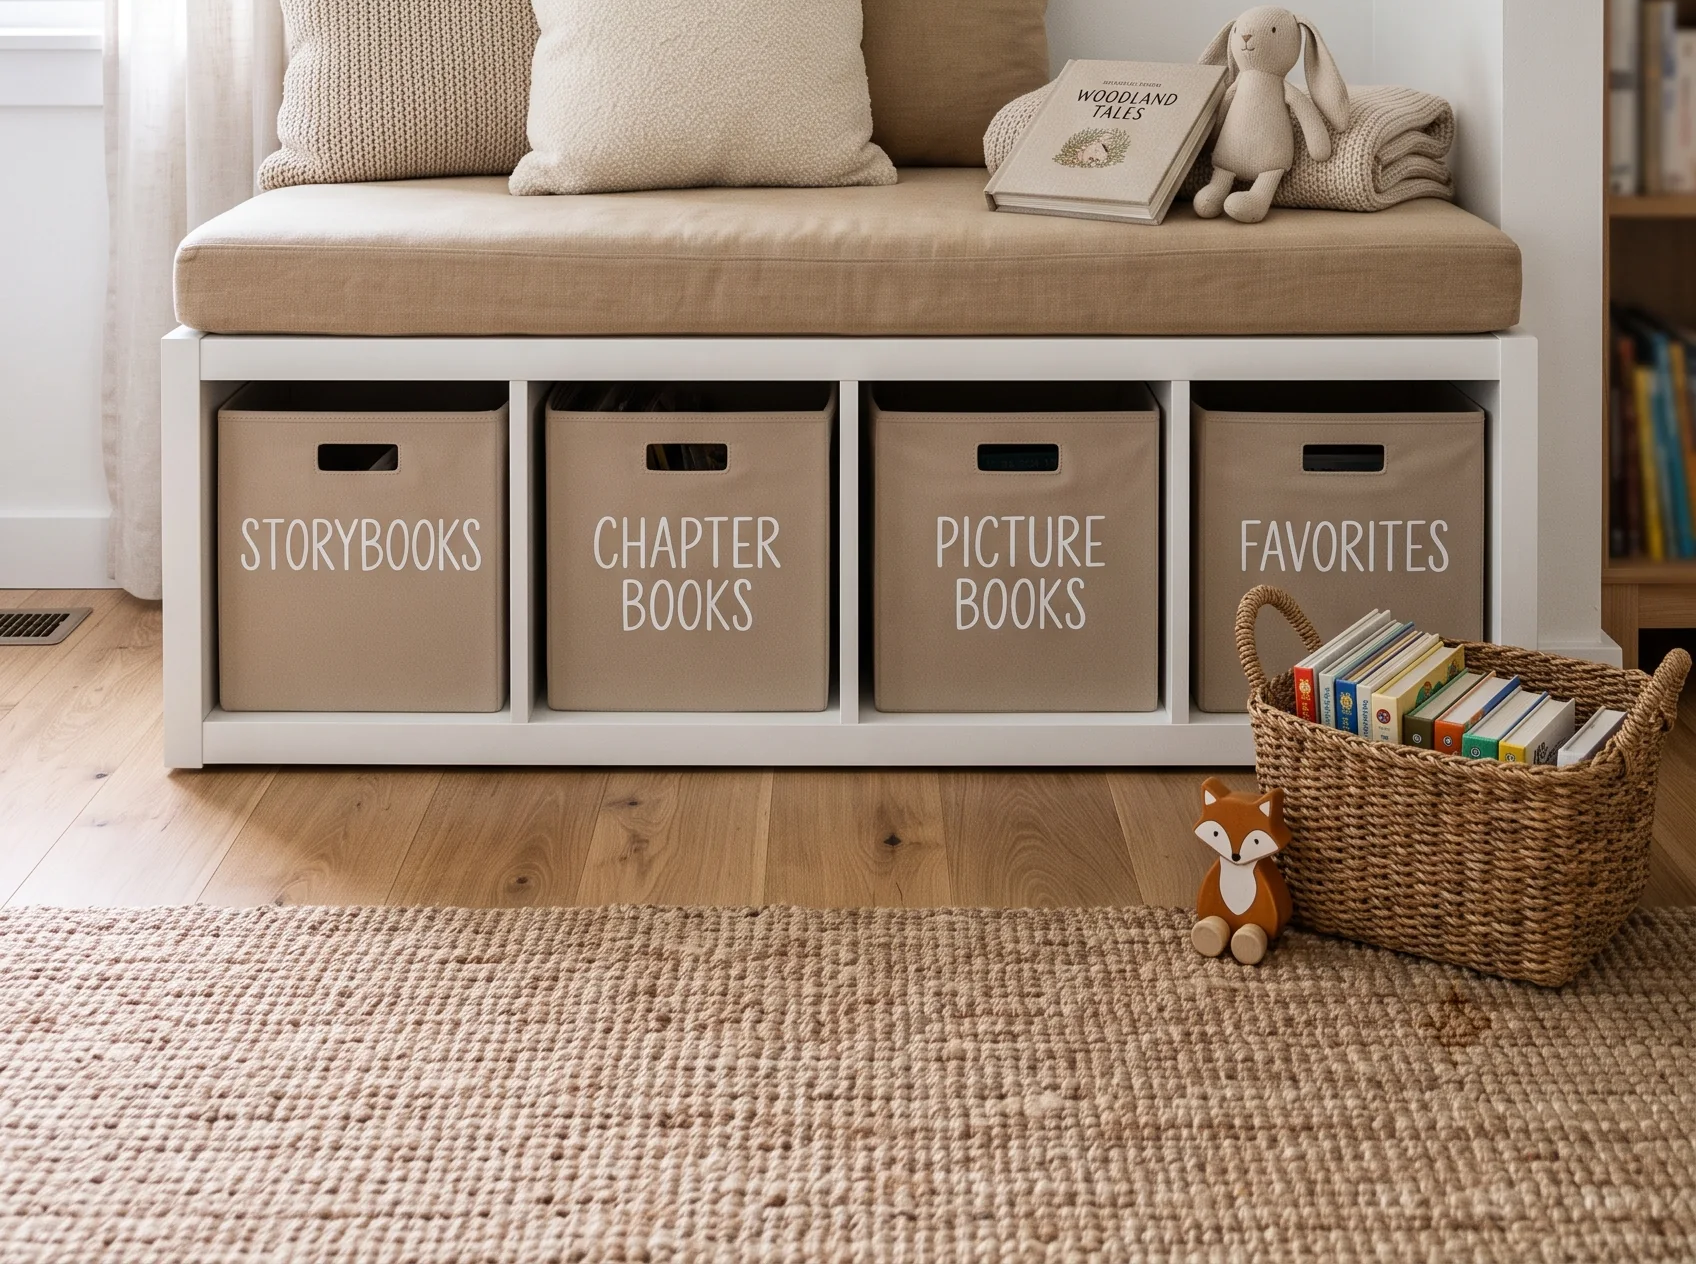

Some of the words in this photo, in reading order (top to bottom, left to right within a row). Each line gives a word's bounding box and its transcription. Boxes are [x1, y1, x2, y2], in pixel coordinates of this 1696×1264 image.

[1077, 89, 1178, 106] WOODLAND
[1093, 104, 1146, 121] TALES
[240, 517, 482, 572] STORYBOOKS
[593, 515, 781, 570] CHAPTER
[936, 515, 1106, 568] PICTURE
[1241, 519, 1450, 573] FAVORITES
[622, 578, 753, 632] BOOKS
[956, 577, 1087, 630] BOOKS
